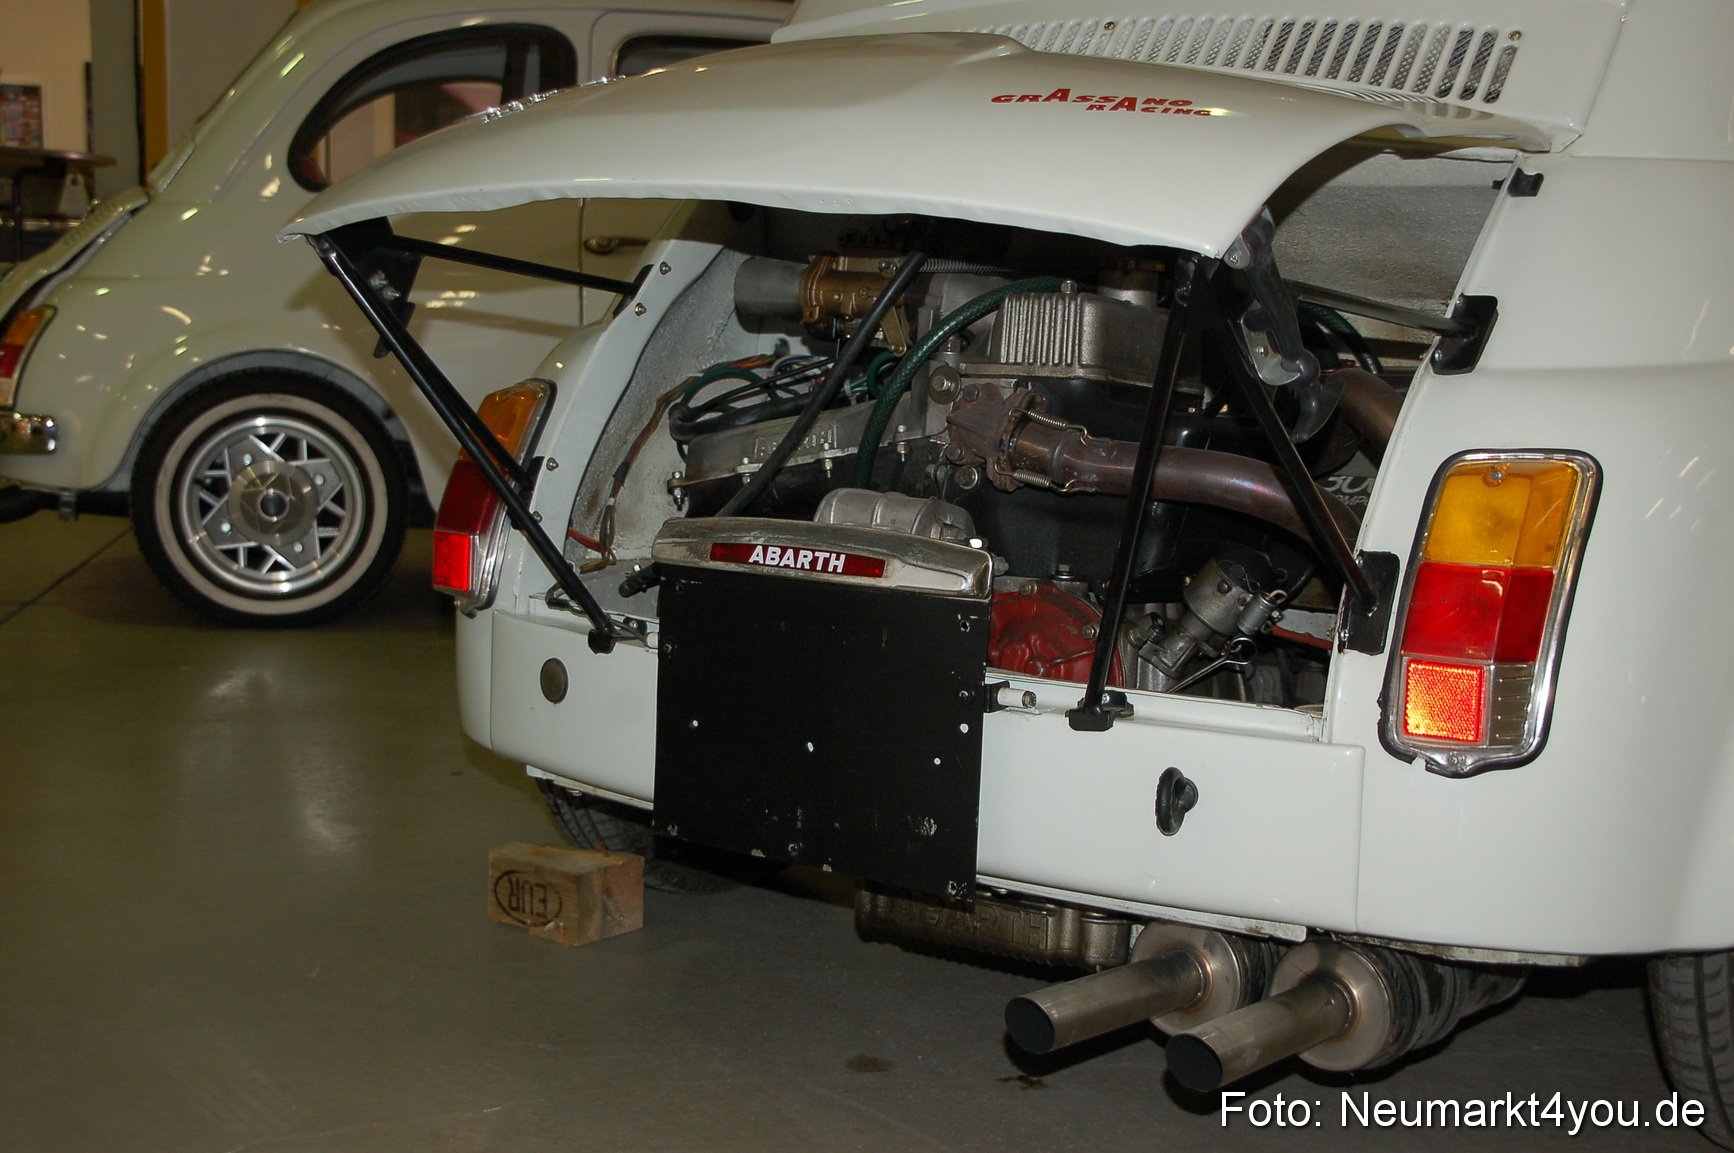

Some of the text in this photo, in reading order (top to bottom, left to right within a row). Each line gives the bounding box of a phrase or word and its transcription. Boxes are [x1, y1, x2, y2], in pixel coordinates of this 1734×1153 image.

[991, 88, 1193, 111] GRASSANO
[1085, 97, 1213, 116] RACING
[748, 544, 846, 574] ABARTH
[508, 876, 549, 919] EUR
